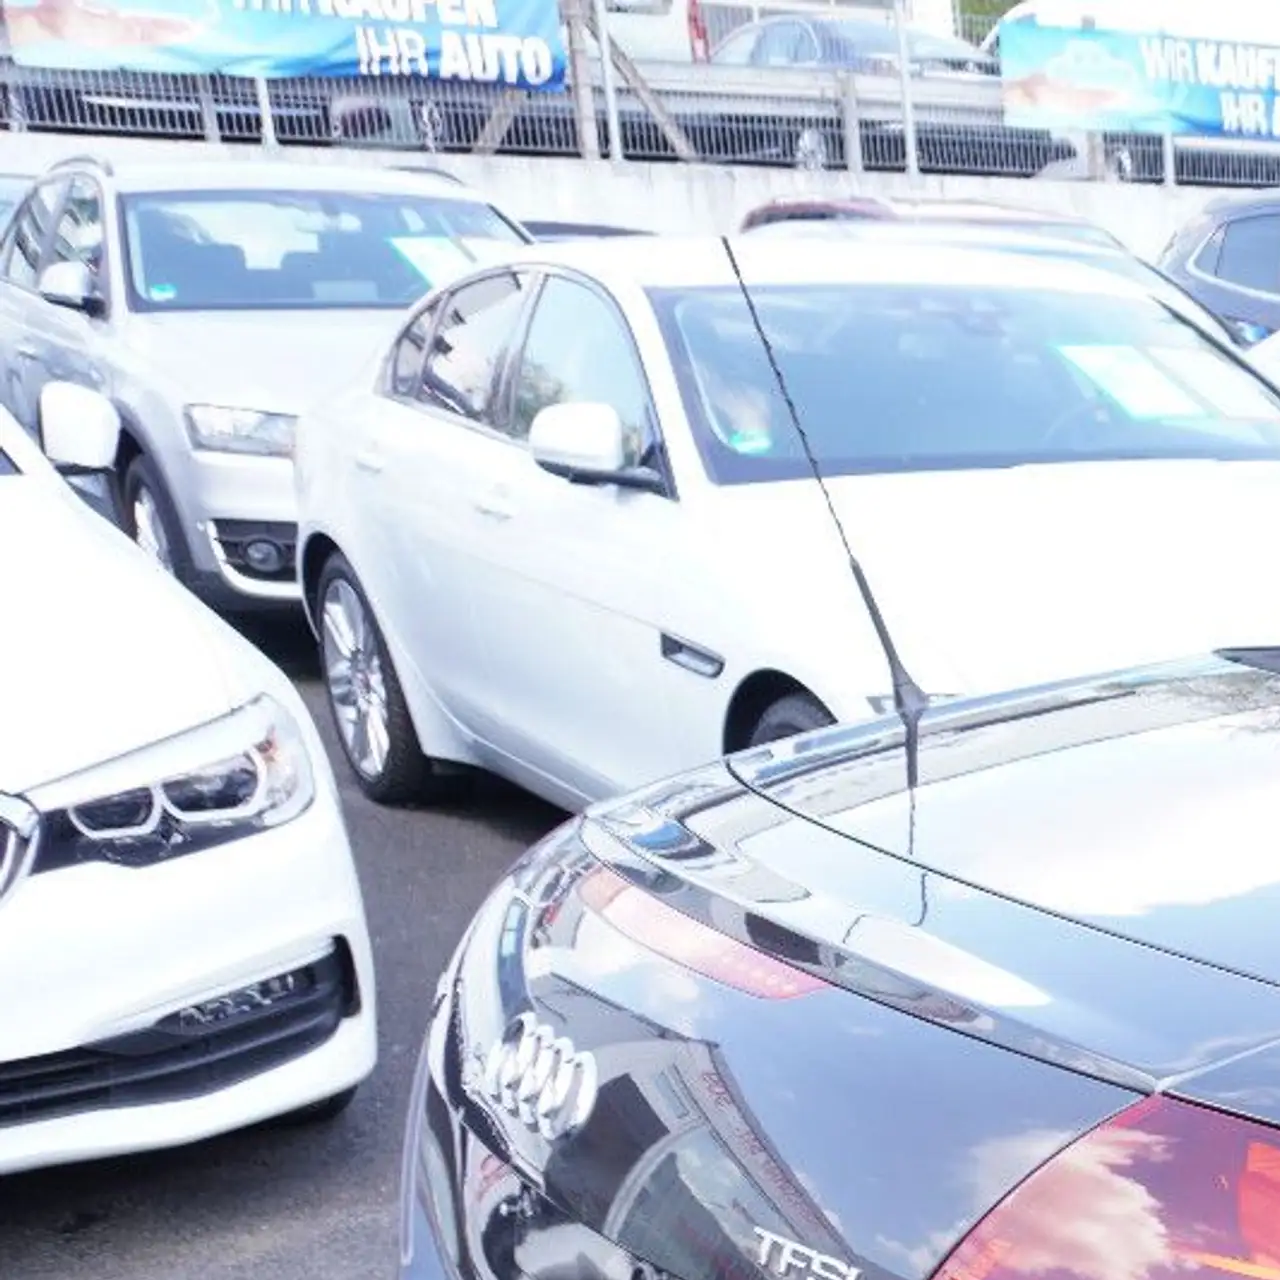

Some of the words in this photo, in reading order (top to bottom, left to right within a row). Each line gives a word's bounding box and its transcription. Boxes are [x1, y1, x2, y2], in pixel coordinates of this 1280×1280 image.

[354, 25, 429, 76] IHR
[440, 30, 553, 86] AUTO
[1138, 36, 1195, 85] WIR
[1219, 91, 1268, 136] IHR
